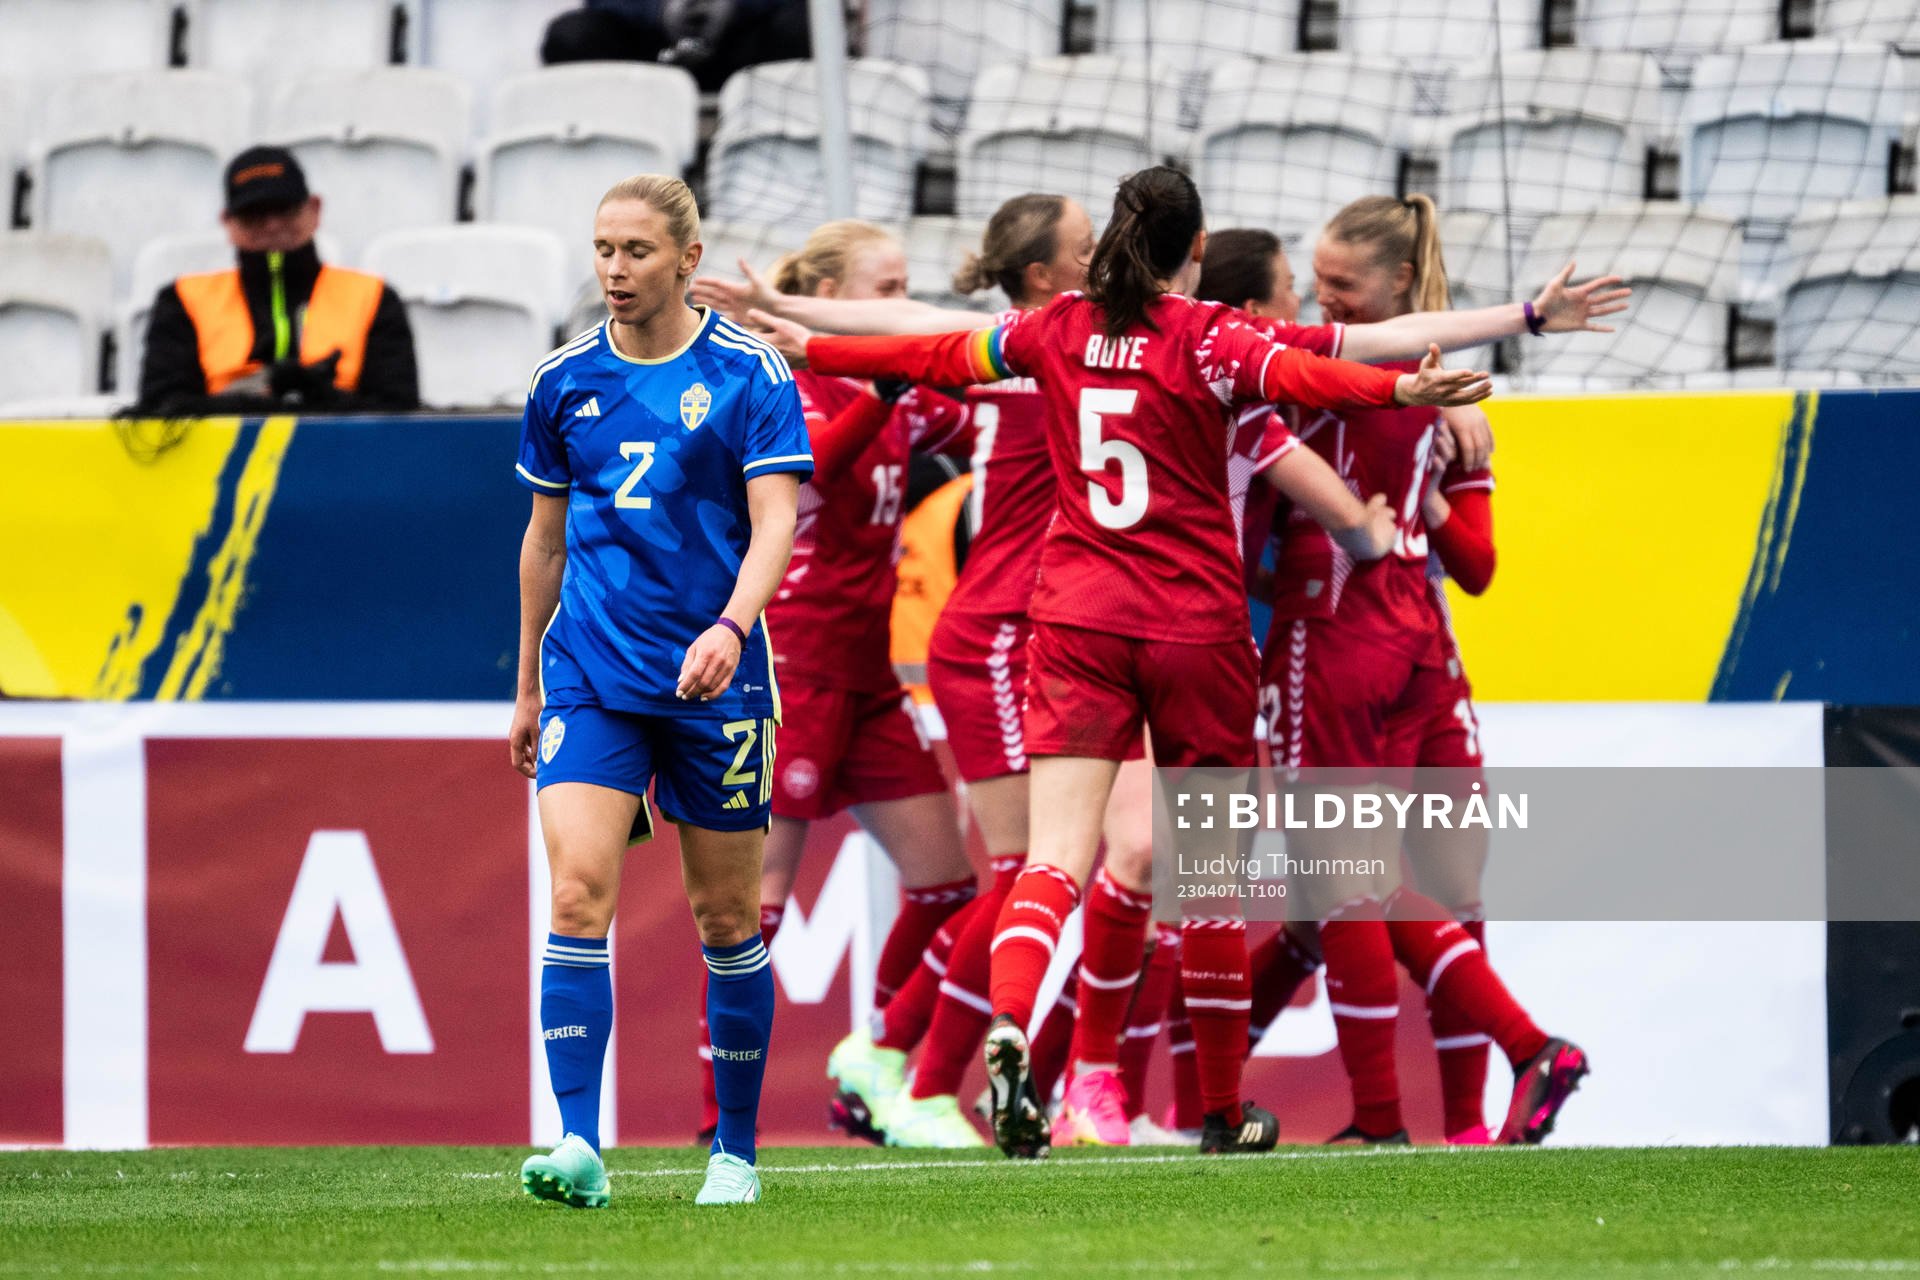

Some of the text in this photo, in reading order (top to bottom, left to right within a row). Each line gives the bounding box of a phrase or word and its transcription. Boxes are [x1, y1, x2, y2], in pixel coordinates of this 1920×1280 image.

[614, 441, 655, 509] 2
[1079, 387, 1149, 529] 5
[869, 465, 903, 525] 15
[722, 719, 757, 786] 2
